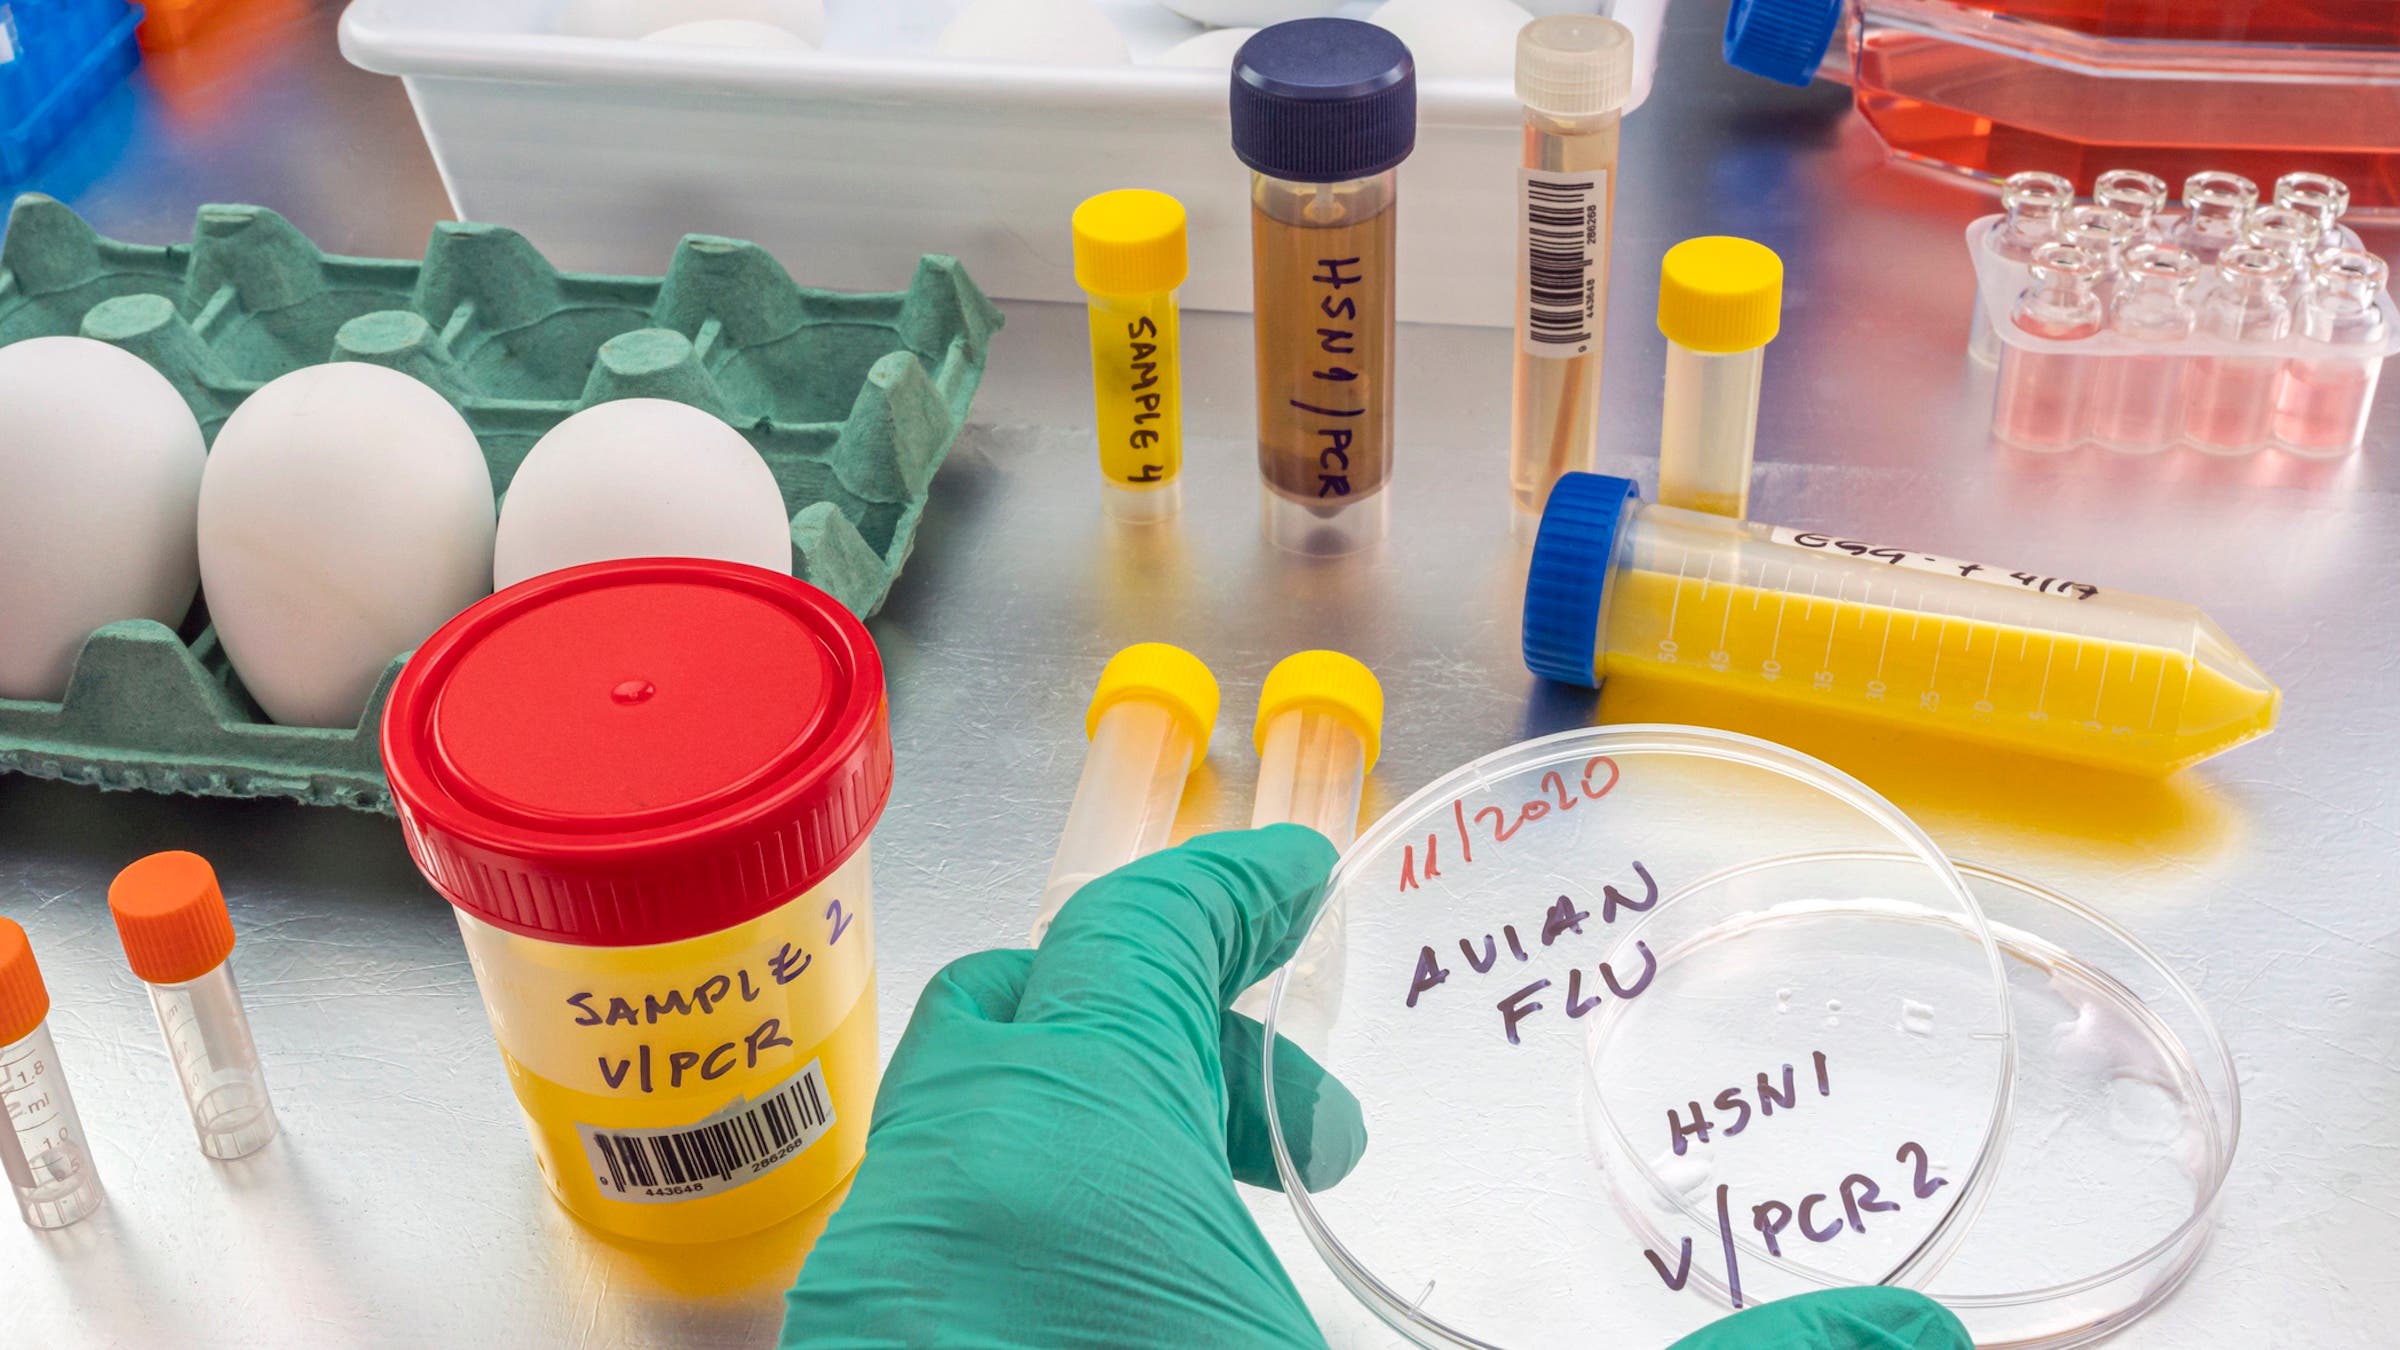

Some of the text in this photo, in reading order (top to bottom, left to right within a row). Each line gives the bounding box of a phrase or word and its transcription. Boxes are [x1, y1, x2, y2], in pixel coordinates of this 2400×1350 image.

[1586, 204, 1597, 245] 286268
[1127, 315, 1164, 483] SAMPLE 4
[1657, 639, 1679, 664] 50
[1399, 756, 1620, 892] 11/2020
[566, 942, 812, 1026] SAMPLE
[825, 898, 853, 945] 2
[1496, 939, 1657, 1045] FLU
[17, 1060, 45, 1084] 1.8
[43, 1127, 68, 1150] 1.0
[645, 1182, 704, 1197] 443648
[751, 1138, 803, 1174] 286268
